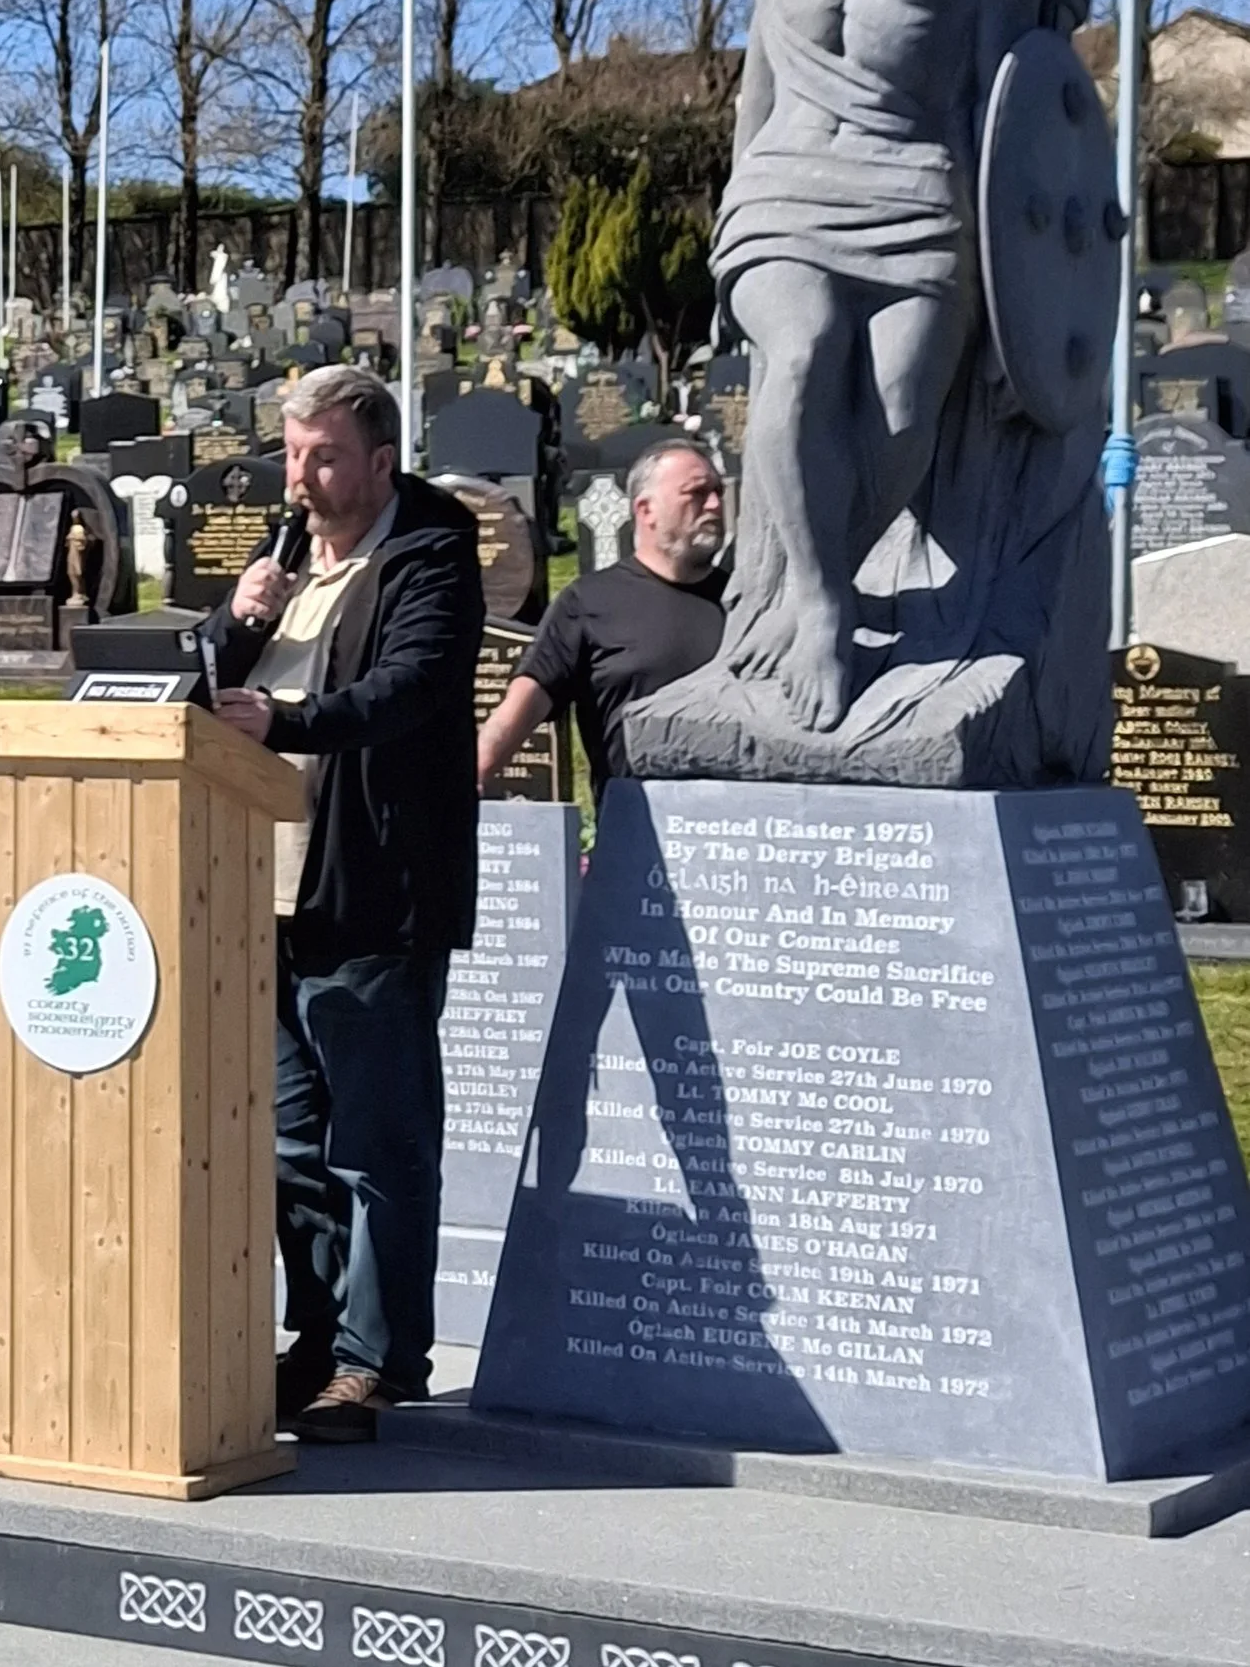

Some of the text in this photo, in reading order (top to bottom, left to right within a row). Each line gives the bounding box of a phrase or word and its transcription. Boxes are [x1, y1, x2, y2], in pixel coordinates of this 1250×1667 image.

[666, 816, 933, 844] Erected (Easter 1975)
[665, 841, 933, 872] By The Derry Brigade
[641, 898, 954, 934] In Honour And In Memory
[65, 936, 94, 961] 32
[690, 926, 900, 954] Of Our Comrades
[603, 946, 994, 986] Who Made The Supreme Sacrifice
[605, 971, 987, 1013] That Our Country Could Be Free
[675, 1035, 725, 1057] Capt.
[779, 1042, 820, 1062] JOE
[827, 1044, 901, 1066] COYLE
[590, 1052, 992, 1096] Killed On Active Service 27th June 1970
[677, 1082, 894, 1114] Lt. TOMMY Mc COOL
[586, 1099, 991, 1146] Killed On Active Service 27th June 1970
[734, 1134, 814, 1157] TOMMY
[820, 1141, 907, 1165] CARLIN
[589, 1147, 983, 1196] Killed On Active Service 8th July 1970
[654, 1176, 910, 1214] Lt. EAMONN LAFFERTY
[626, 1197, 684, 1218] Killed
[717, 1205, 780, 1227] Action
[788, 1210, 833, 1232] 18th
[839, 1215, 881, 1240] Aug
[889, 1219, 937, 1242] 1971
[726, 1230, 798, 1254] JAMES
[804, 1236, 909, 1264] O'HAGAN
[582, 1242, 981, 1295] Killed On Active Service 19th Aug 1971
[641, 1271, 692, 1296] Capt.
[747, 1281, 810, 1305] COLM
[816, 1288, 915, 1315] KEENAN
[569, 1288, 992, 1348] Killed On Active Service 14th March 1972
[703, 1323, 797, 1352] EUGENE
[801, 1335, 833, 1355] Mc
[837, 1338, 924, 1367] GILLAN
[567, 1337, 989, 1399] Killed On Active Service 14th March 1972
